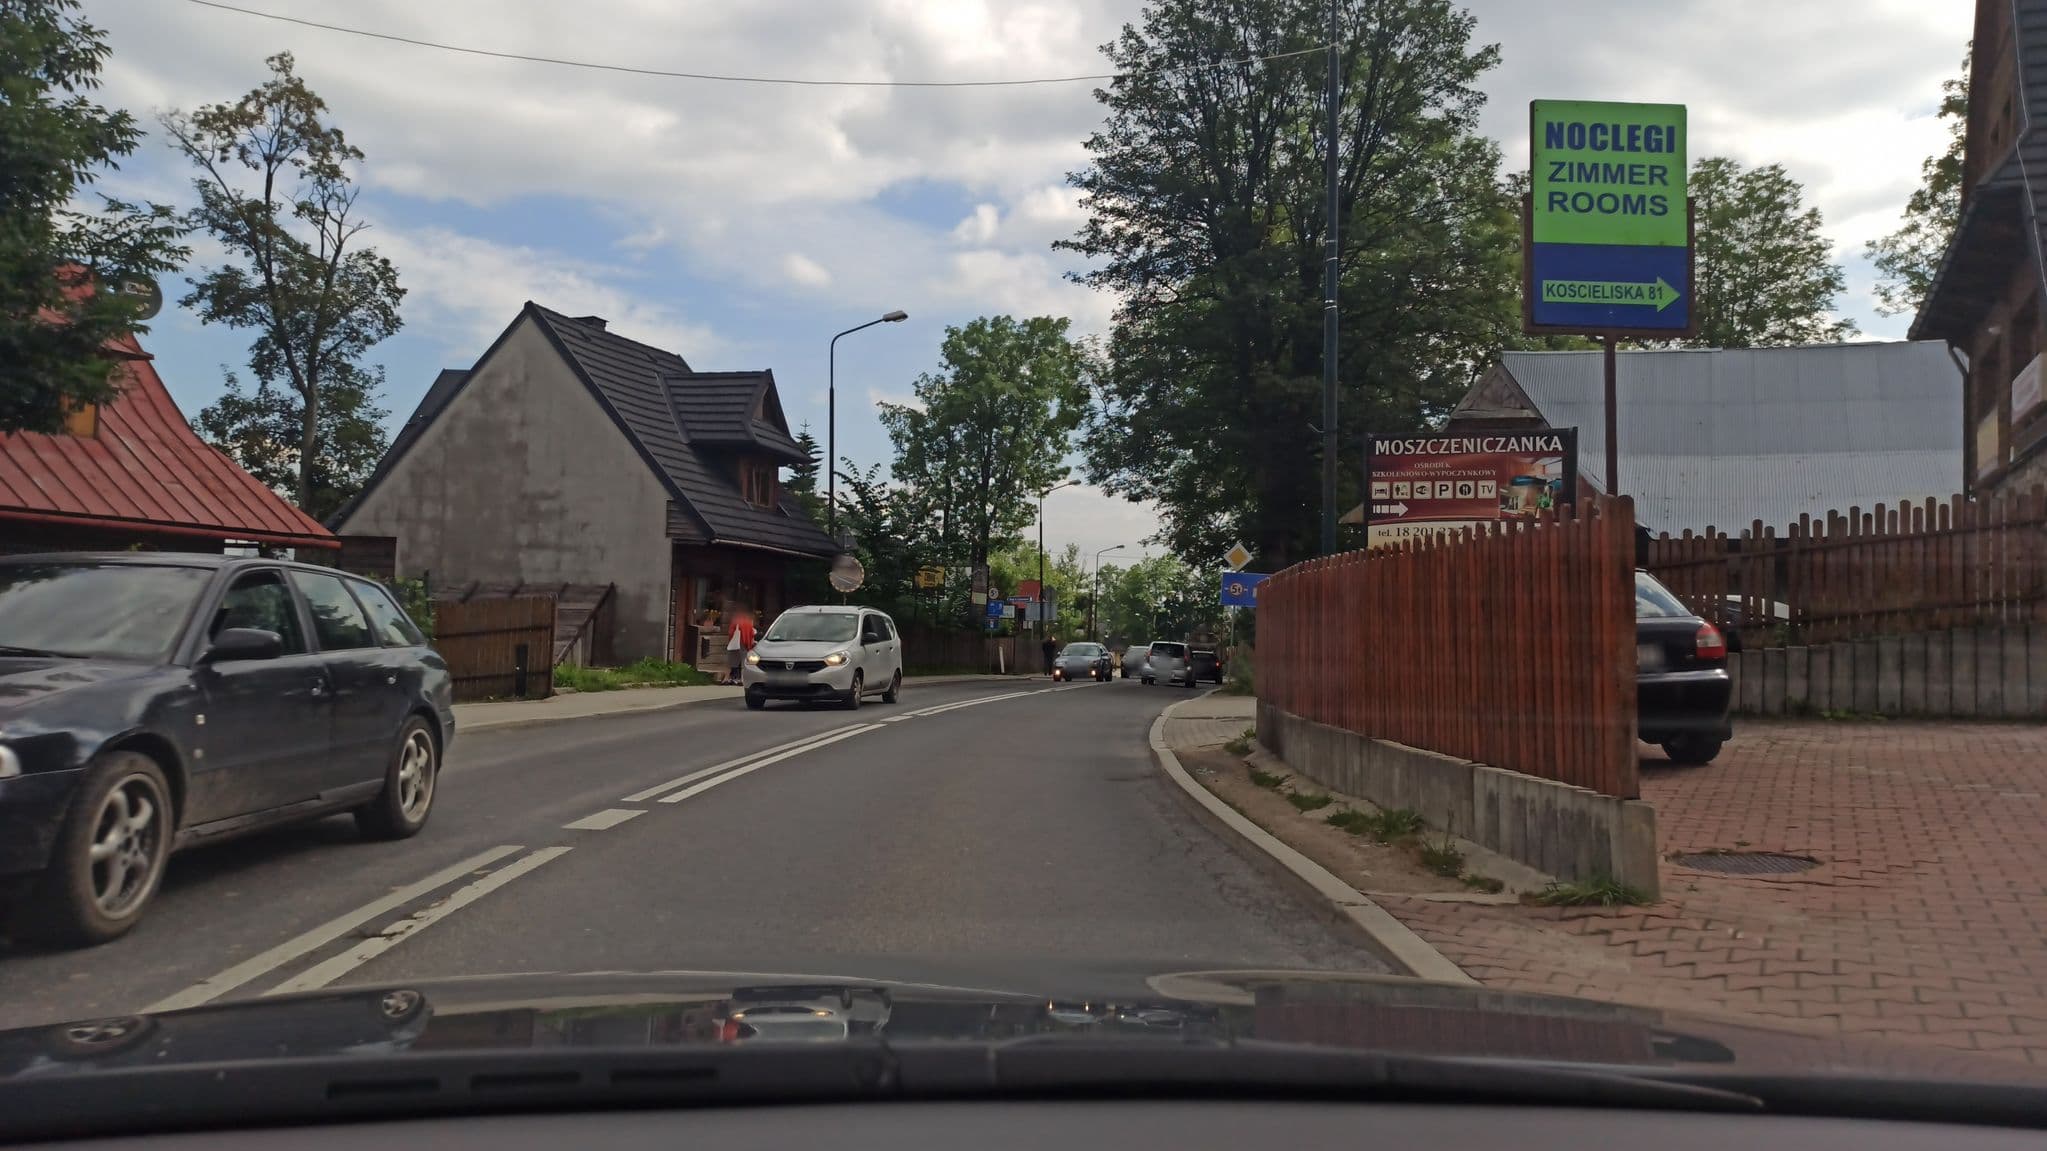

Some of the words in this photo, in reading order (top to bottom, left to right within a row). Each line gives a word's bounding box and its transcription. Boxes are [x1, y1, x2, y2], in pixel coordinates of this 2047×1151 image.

[1545, 121, 1675, 153] NOCLEGI
[1548, 161, 1669, 186] ZIMMER
[1548, 191, 1668, 216] ROOMS
[1648, 286, 1663, 300] 81
[1375, 435, 1563, 455] MOSZCZENICZANKA
[1480, 484, 1494, 494] TV
[1378, 528, 1392, 537] tel.
[1396, 527, 1410, 537] 18
